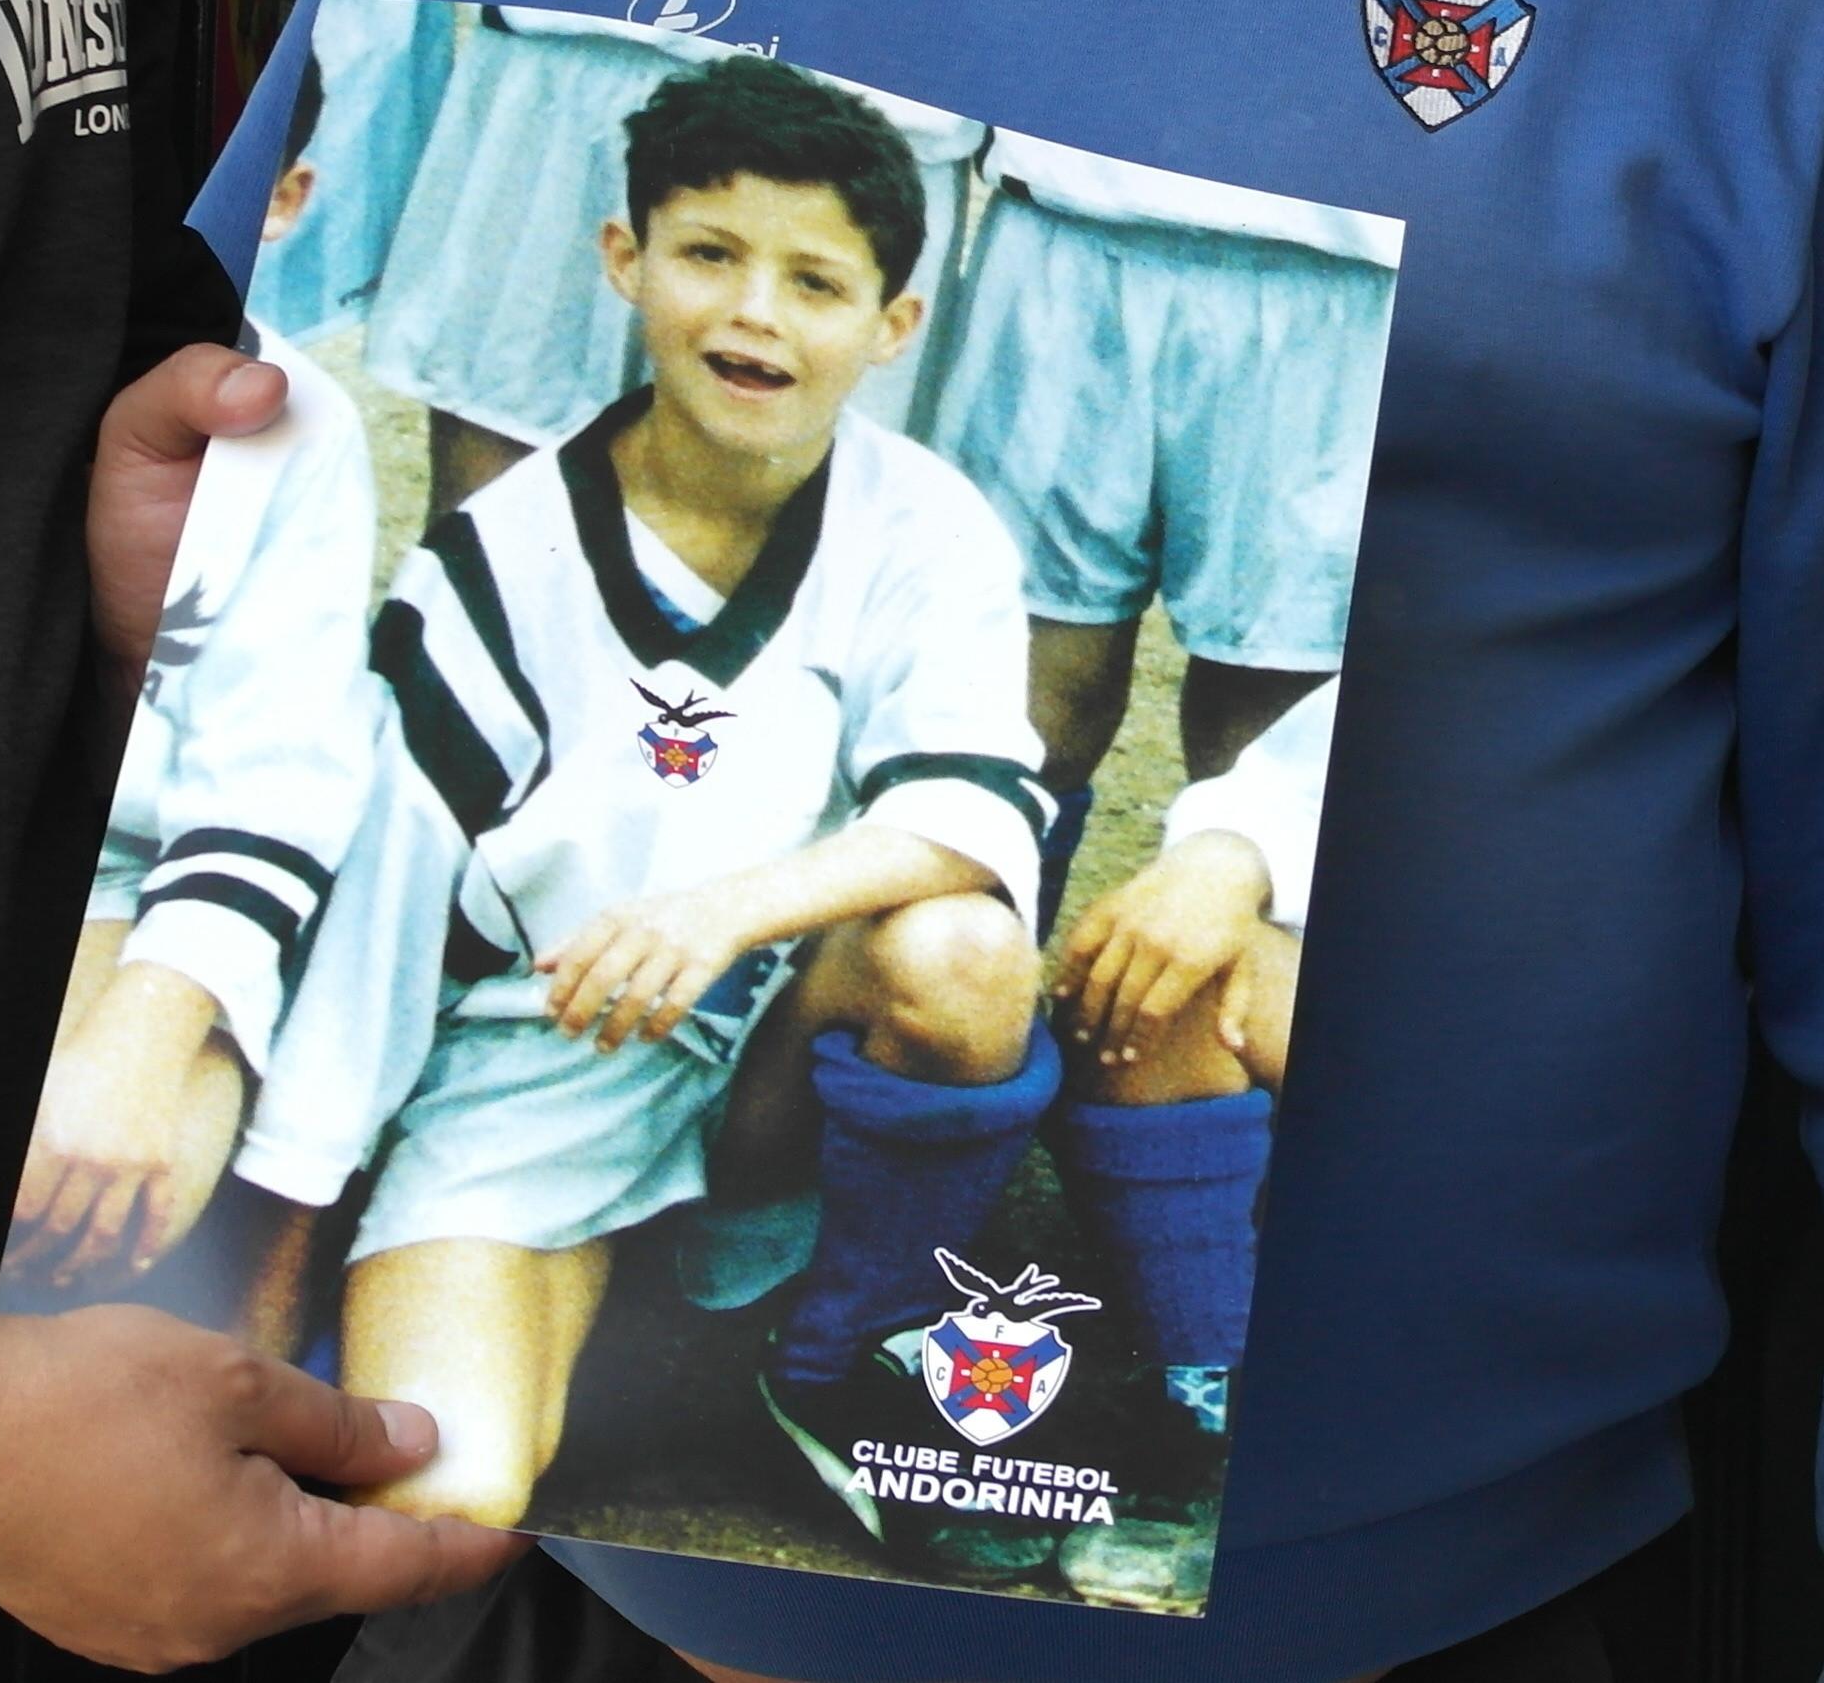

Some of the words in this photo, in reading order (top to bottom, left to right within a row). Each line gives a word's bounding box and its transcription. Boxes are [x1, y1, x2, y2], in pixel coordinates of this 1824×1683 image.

[1373, 25, 1387, 48] C
[1494, 46, 1508, 68] A
[994, 1324, 1005, 1339] F
[935, 1365, 947, 1382] C
[1035, 1378, 1047, 1395] A
[851, 1439, 960, 1474] CLUBE
[972, 1454, 1119, 1494] FUTEBOL
[845, 1466, 1115, 1526] ANDORINHA
